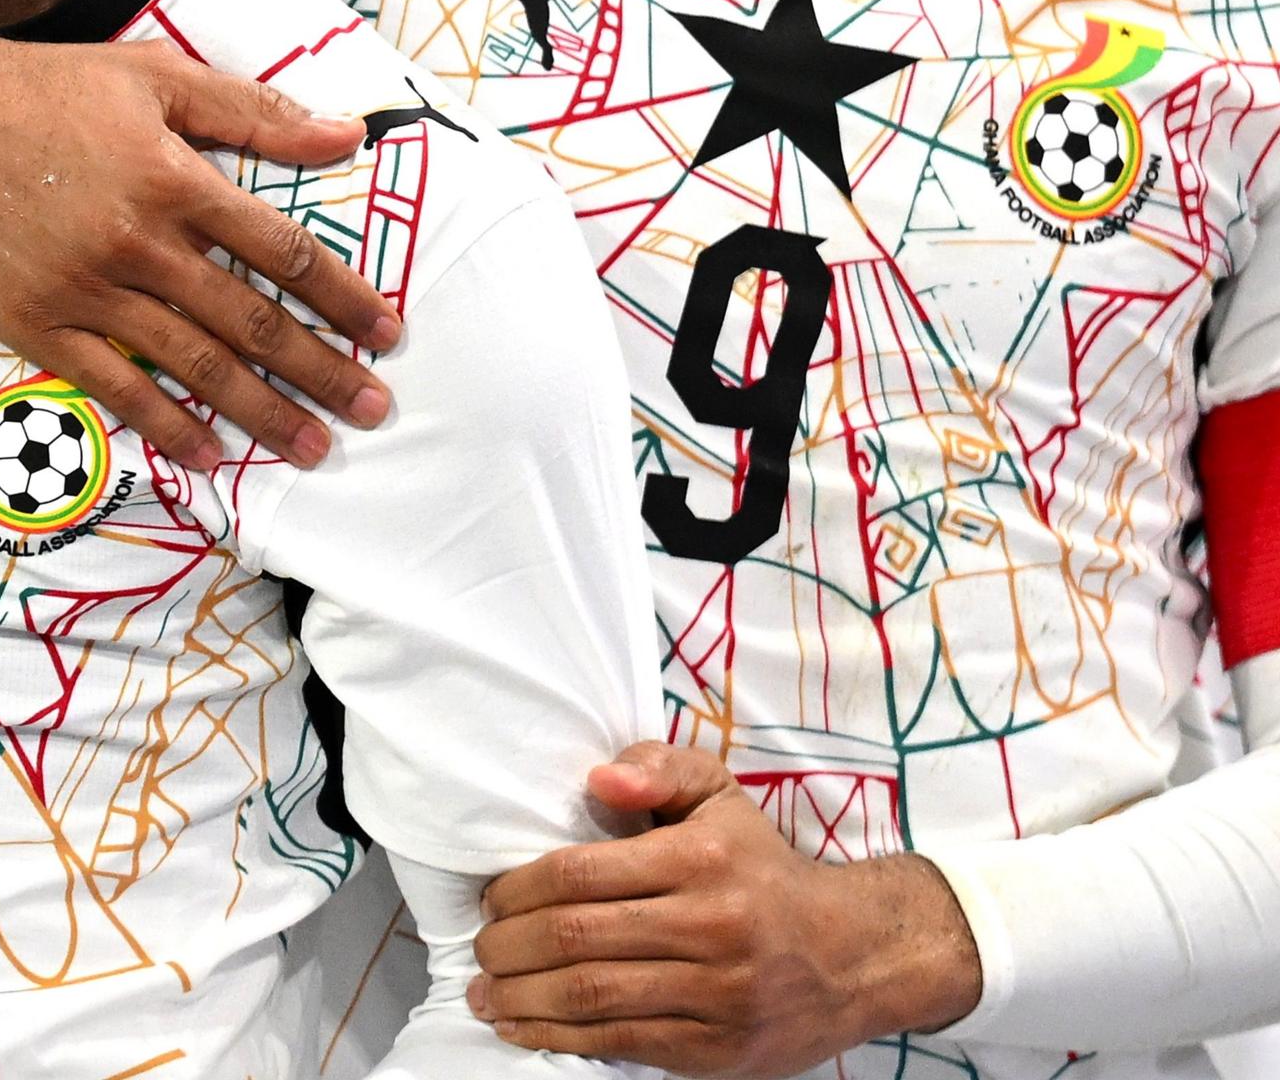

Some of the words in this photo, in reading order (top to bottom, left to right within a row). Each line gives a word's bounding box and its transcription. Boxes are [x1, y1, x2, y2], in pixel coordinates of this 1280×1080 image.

[1000, 187, 1081, 245] FOOTBALL
[1079, 153, 1162, 244] ASSOCIATION
[640, 223, 827, 564] 9
